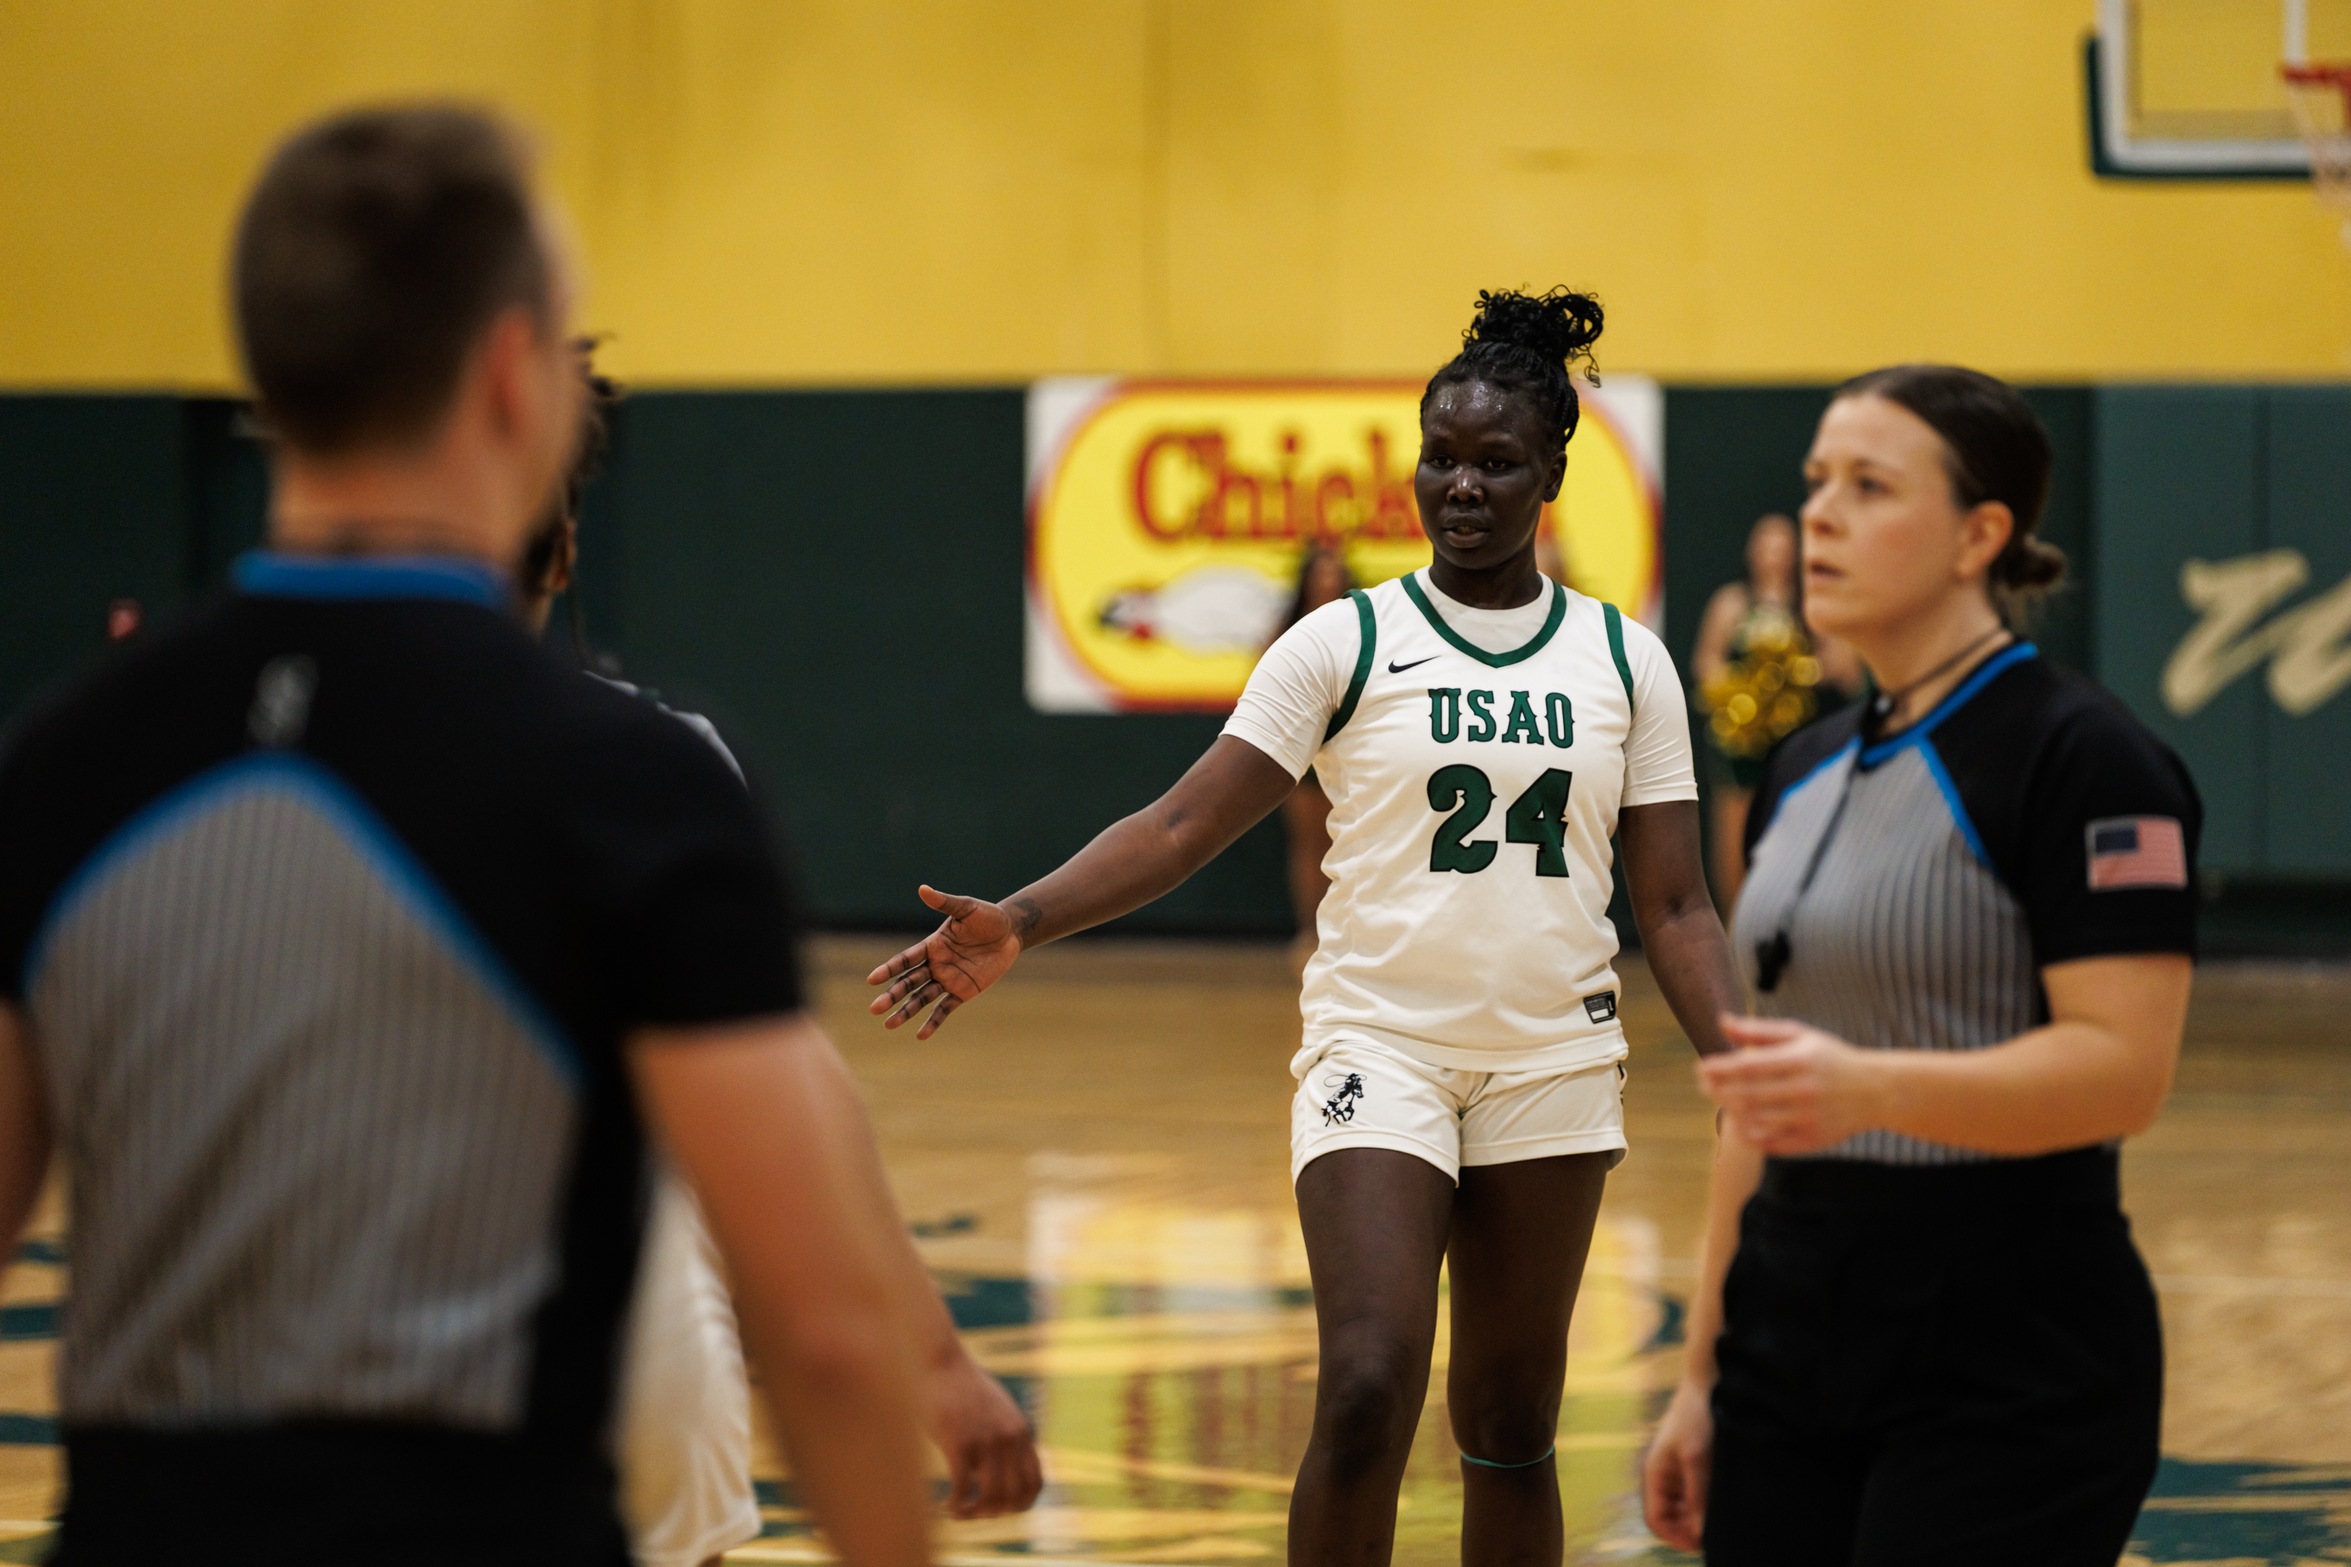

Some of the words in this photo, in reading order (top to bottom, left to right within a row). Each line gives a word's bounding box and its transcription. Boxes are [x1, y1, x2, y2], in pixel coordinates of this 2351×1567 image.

[1128, 428, 1554, 541] Chick
[1427, 687, 1575, 749] USAO
[1426, 763, 1573, 878] 24
